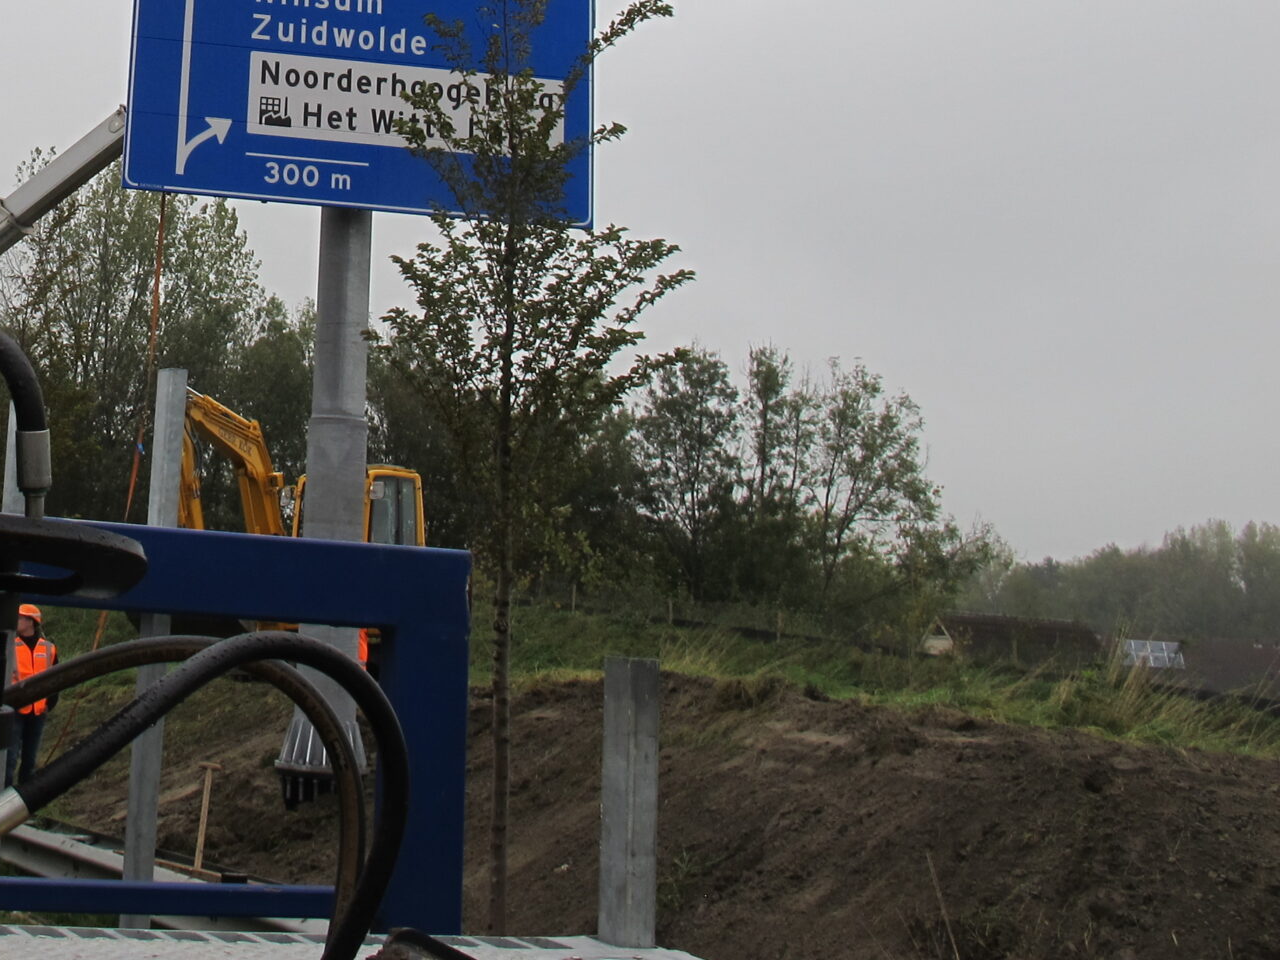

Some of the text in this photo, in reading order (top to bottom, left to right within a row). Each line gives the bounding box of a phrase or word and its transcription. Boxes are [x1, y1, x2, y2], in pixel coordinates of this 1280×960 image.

[251, 13, 427, 56] Zuidwolde
[303, 102, 358, 132] Het
[264, 161, 351, 190] 300 m
